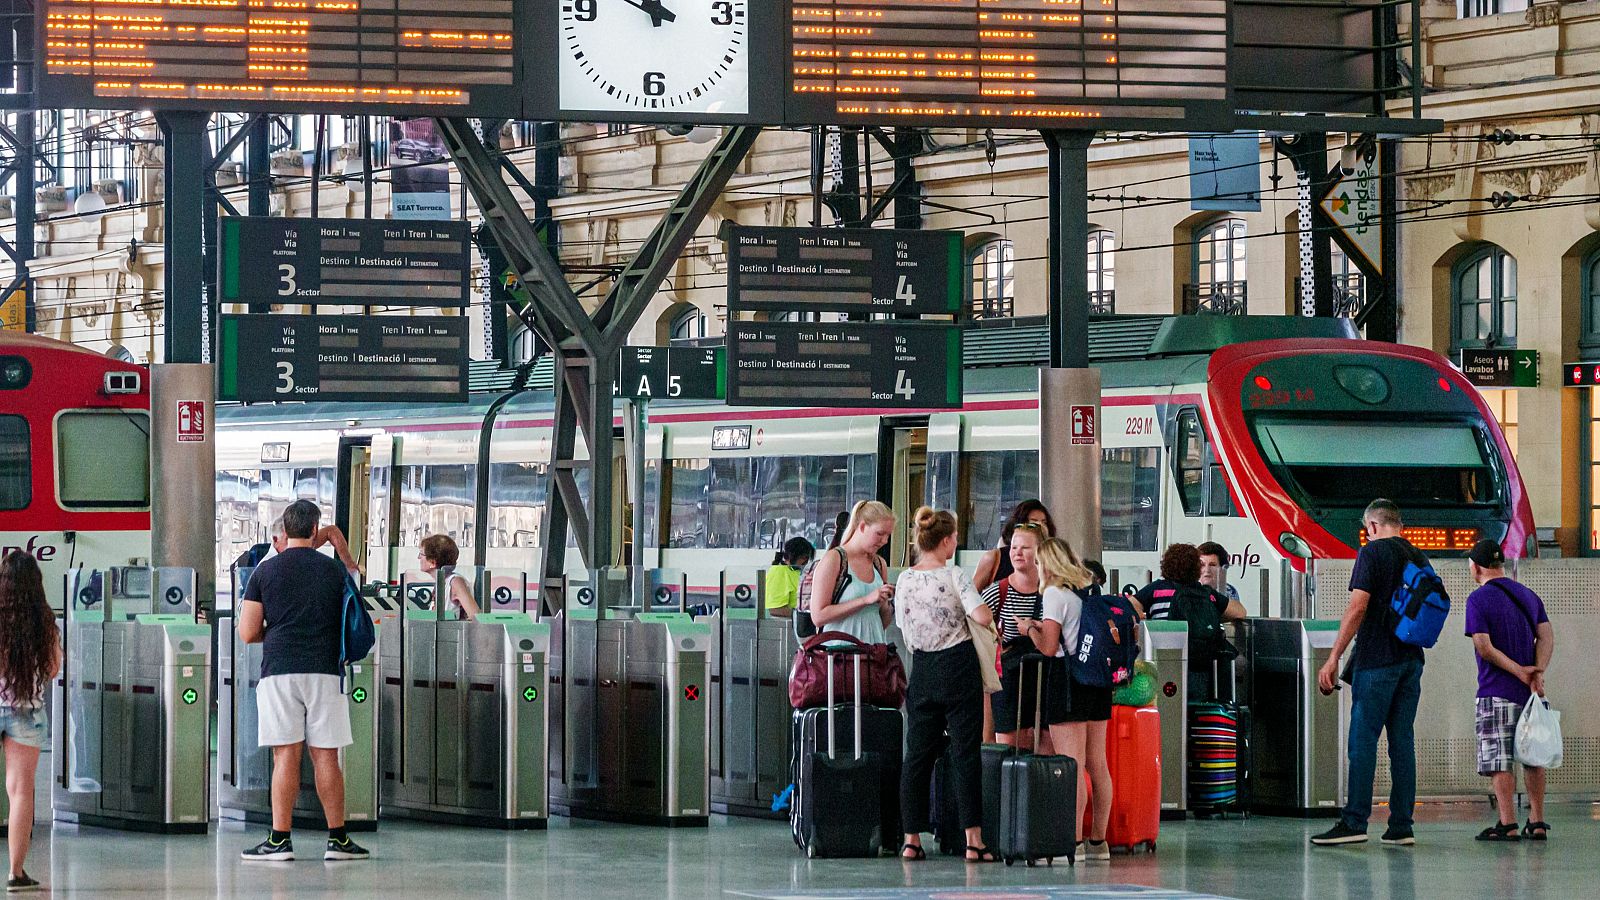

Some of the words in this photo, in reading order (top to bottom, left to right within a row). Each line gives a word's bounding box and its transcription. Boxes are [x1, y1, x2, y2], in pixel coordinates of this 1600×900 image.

[574, 0, 598, 22] 9
[710, 1, 733, 26] 3
[643, 72, 666, 96] 6
[396, 204, 415, 212] SEAT
[285, 230, 296, 238] Vía
[384, 230, 400, 238] Tren
[285, 240, 296, 248] Via
[799, 238, 814, 246] Tren
[897, 242, 907, 250] Vía
[897, 251, 907, 259] Via
[321, 257, 349, 265] Destino
[361, 258, 402, 266] Destinació
[740, 265, 767, 273] Destino
[778, 265, 816, 274] Destinació
[278, 264, 297, 296] 3
[895, 276, 916, 306] 4
[283, 327, 294, 336] Vía
[319, 326, 337, 334] Hora
[382, 326, 398, 334] Tren
[739, 332, 756, 340] Hora
[799, 333, 813, 341] Tren
[822, 333, 837, 341] Tren
[896, 336, 906, 344] Vía
[283, 337, 294, 345] Via
[319, 354, 348, 362] Destino
[359, 354, 400, 363] Destinació
[1473, 355, 1494, 364] Aseos
[739, 360, 766, 368] Destino
[777, 361, 815, 369] Destinació
[1465, 365, 1495, 373] Lavabos
[276, 362, 293, 394] 3
[296, 386, 318, 394] Sector
[637, 375, 651, 396] A
[669, 375, 681, 397] 5
[872, 392, 892, 400] Sector
[895, 370, 915, 400] 4
[1125, 417, 1143, 435] 229
[1143, 417, 1153, 434] M
[1228, 543, 1261, 579] nfe
